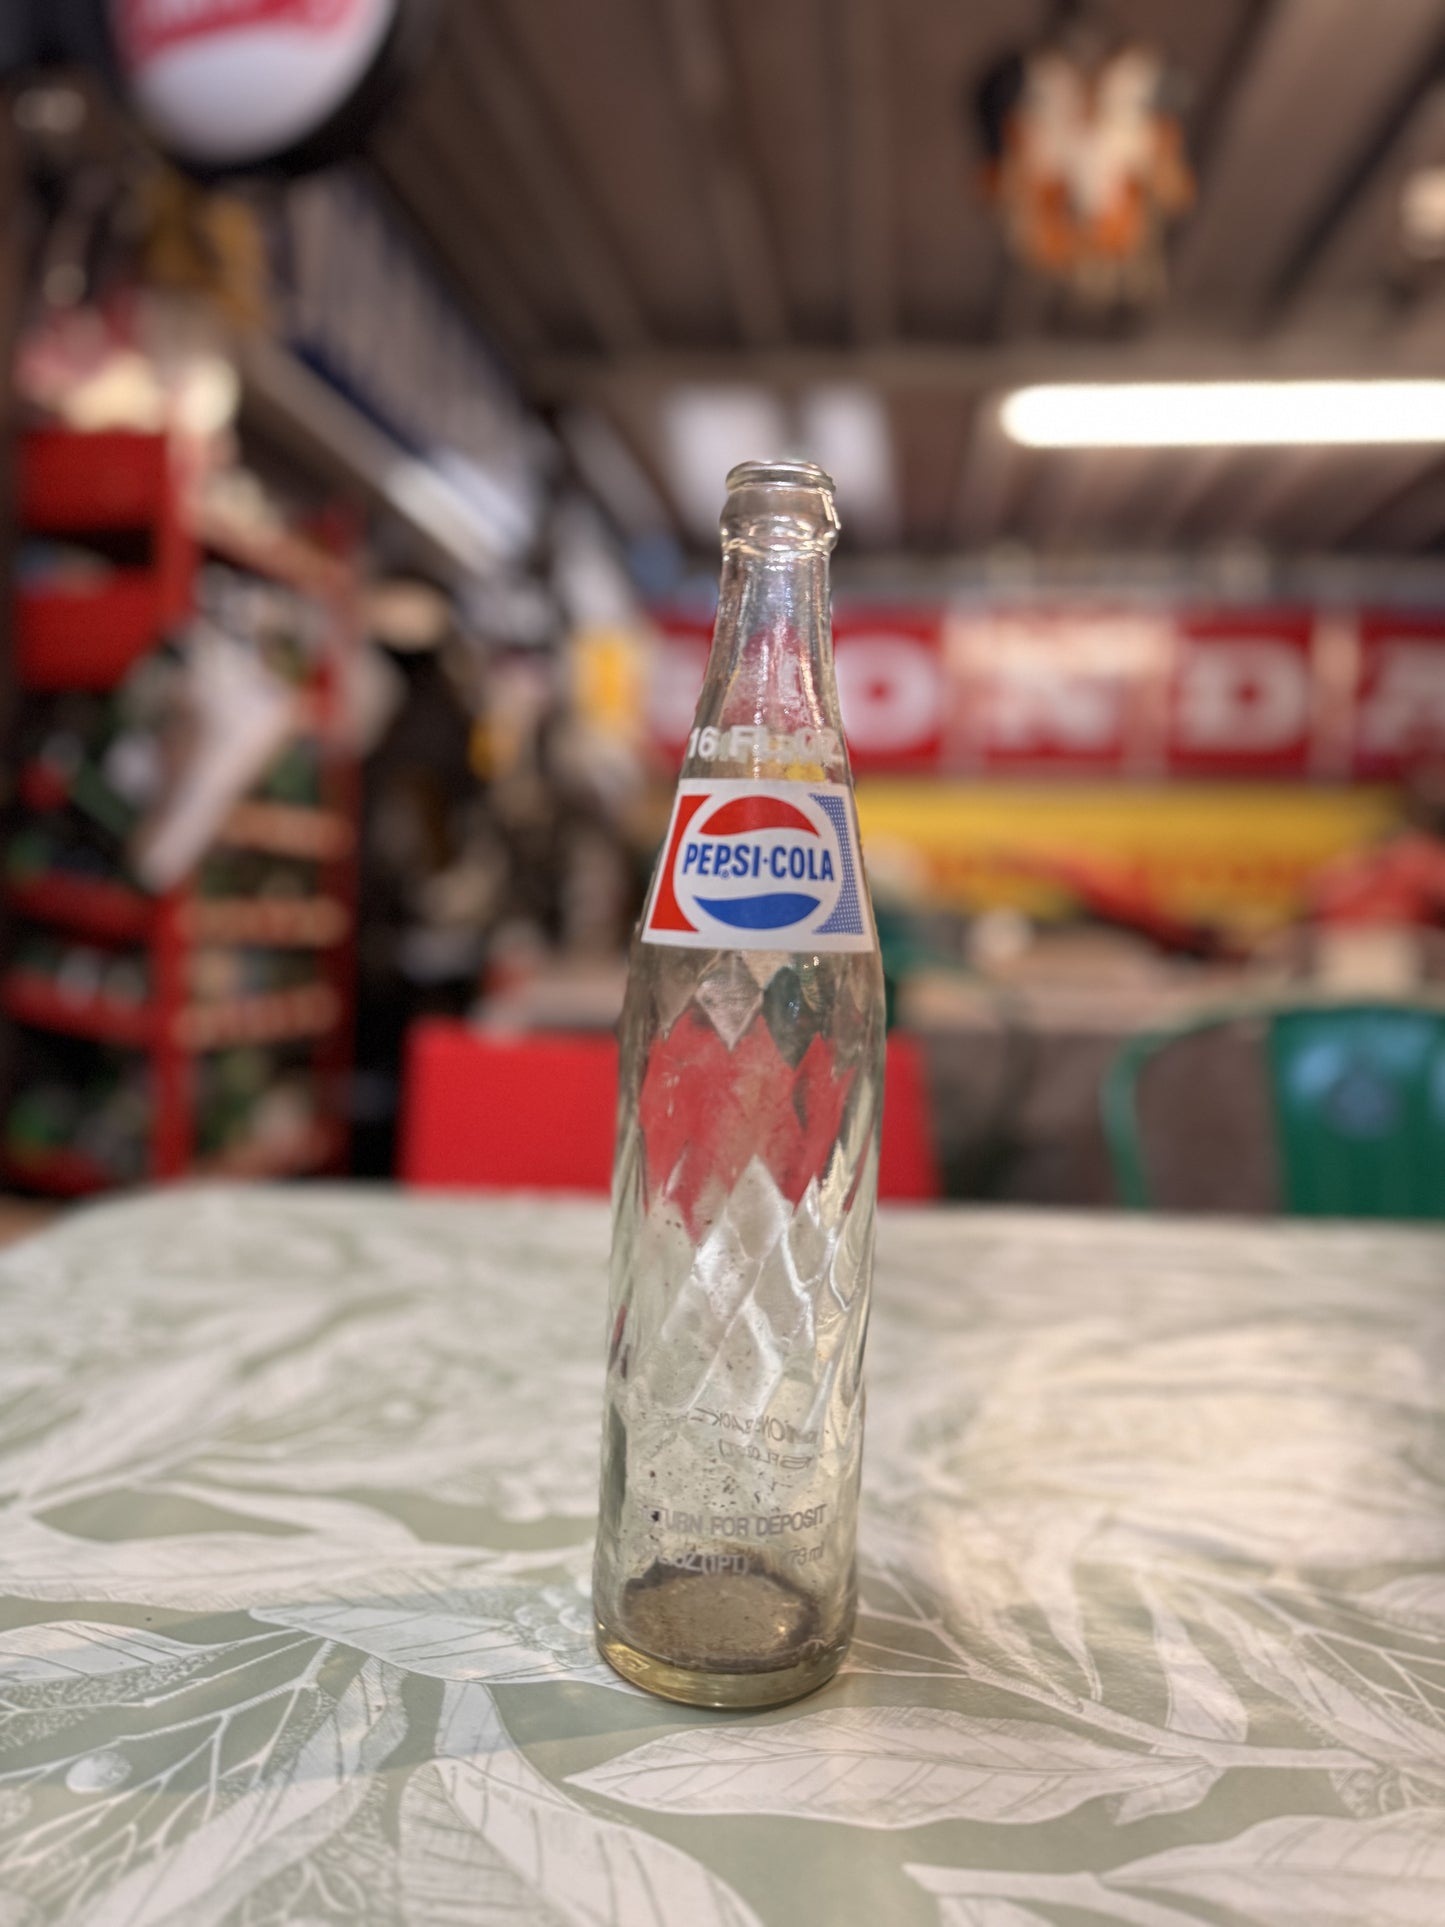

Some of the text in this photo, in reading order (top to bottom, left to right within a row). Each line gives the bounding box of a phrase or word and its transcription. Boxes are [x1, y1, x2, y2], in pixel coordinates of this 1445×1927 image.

[688, 726, 719, 760] 16
[710, 1515, 751, 1537] FOR
[755, 1503, 827, 1537] DEPOSIT
